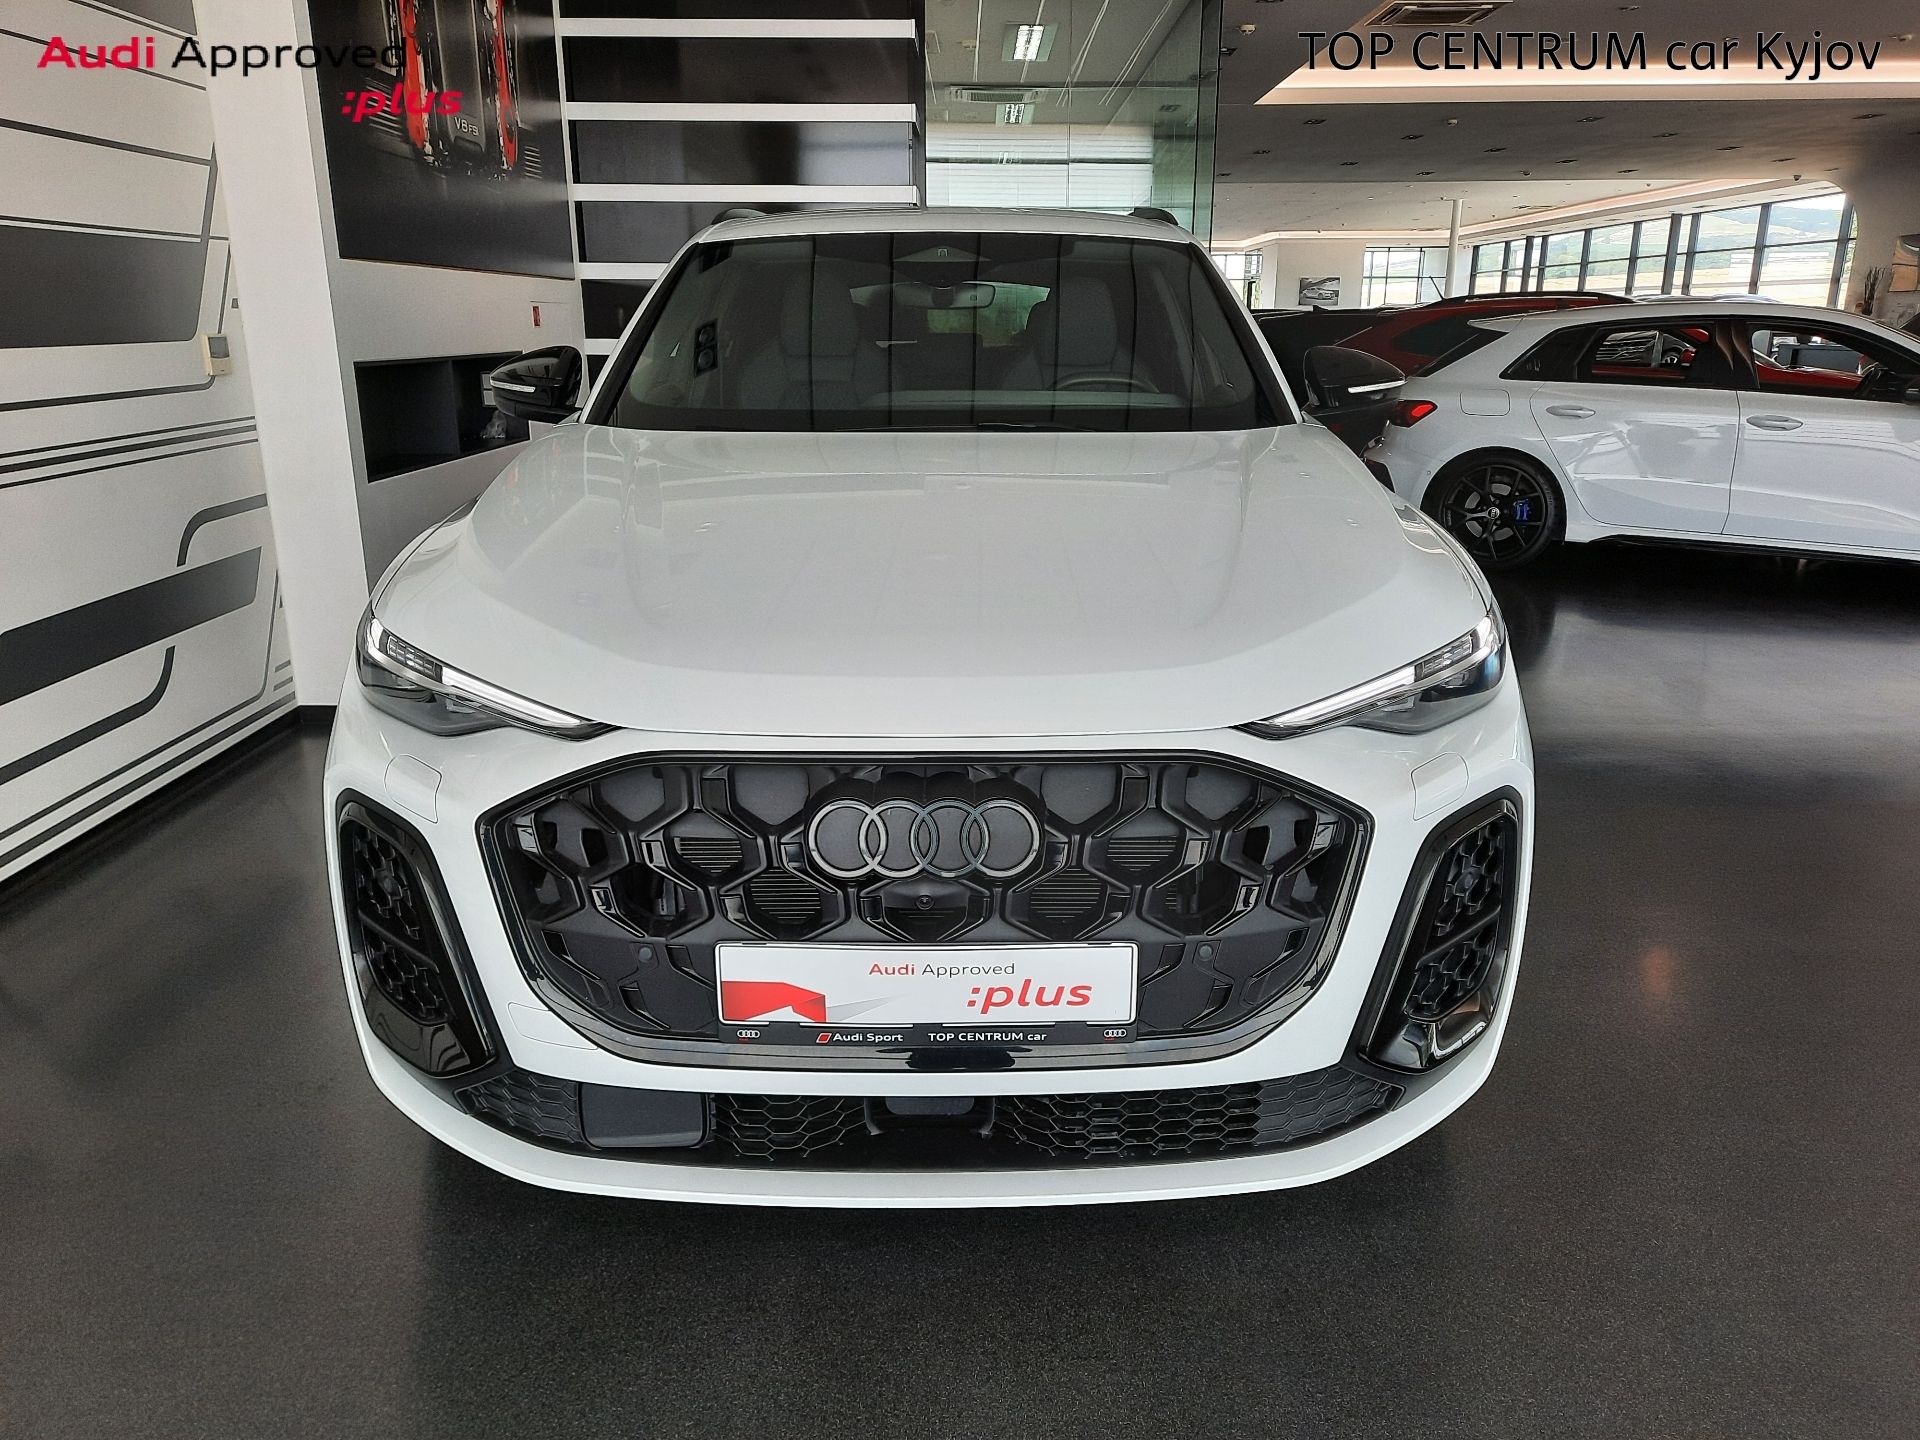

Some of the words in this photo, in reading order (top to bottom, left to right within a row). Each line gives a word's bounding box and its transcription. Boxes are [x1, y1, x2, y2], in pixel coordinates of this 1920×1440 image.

[868, 962, 916, 976] Audi
[921, 962, 1016, 979] Approved
[966, 979, 1092, 1015] :plus
[832, 1032, 863, 1042] Audi
[866, 1032, 904, 1045] Sport
[928, 1032, 955, 1042] TOP
[958, 1032, 1024, 1042] CENTRUM
[1027, 1033, 1047, 1042] car
